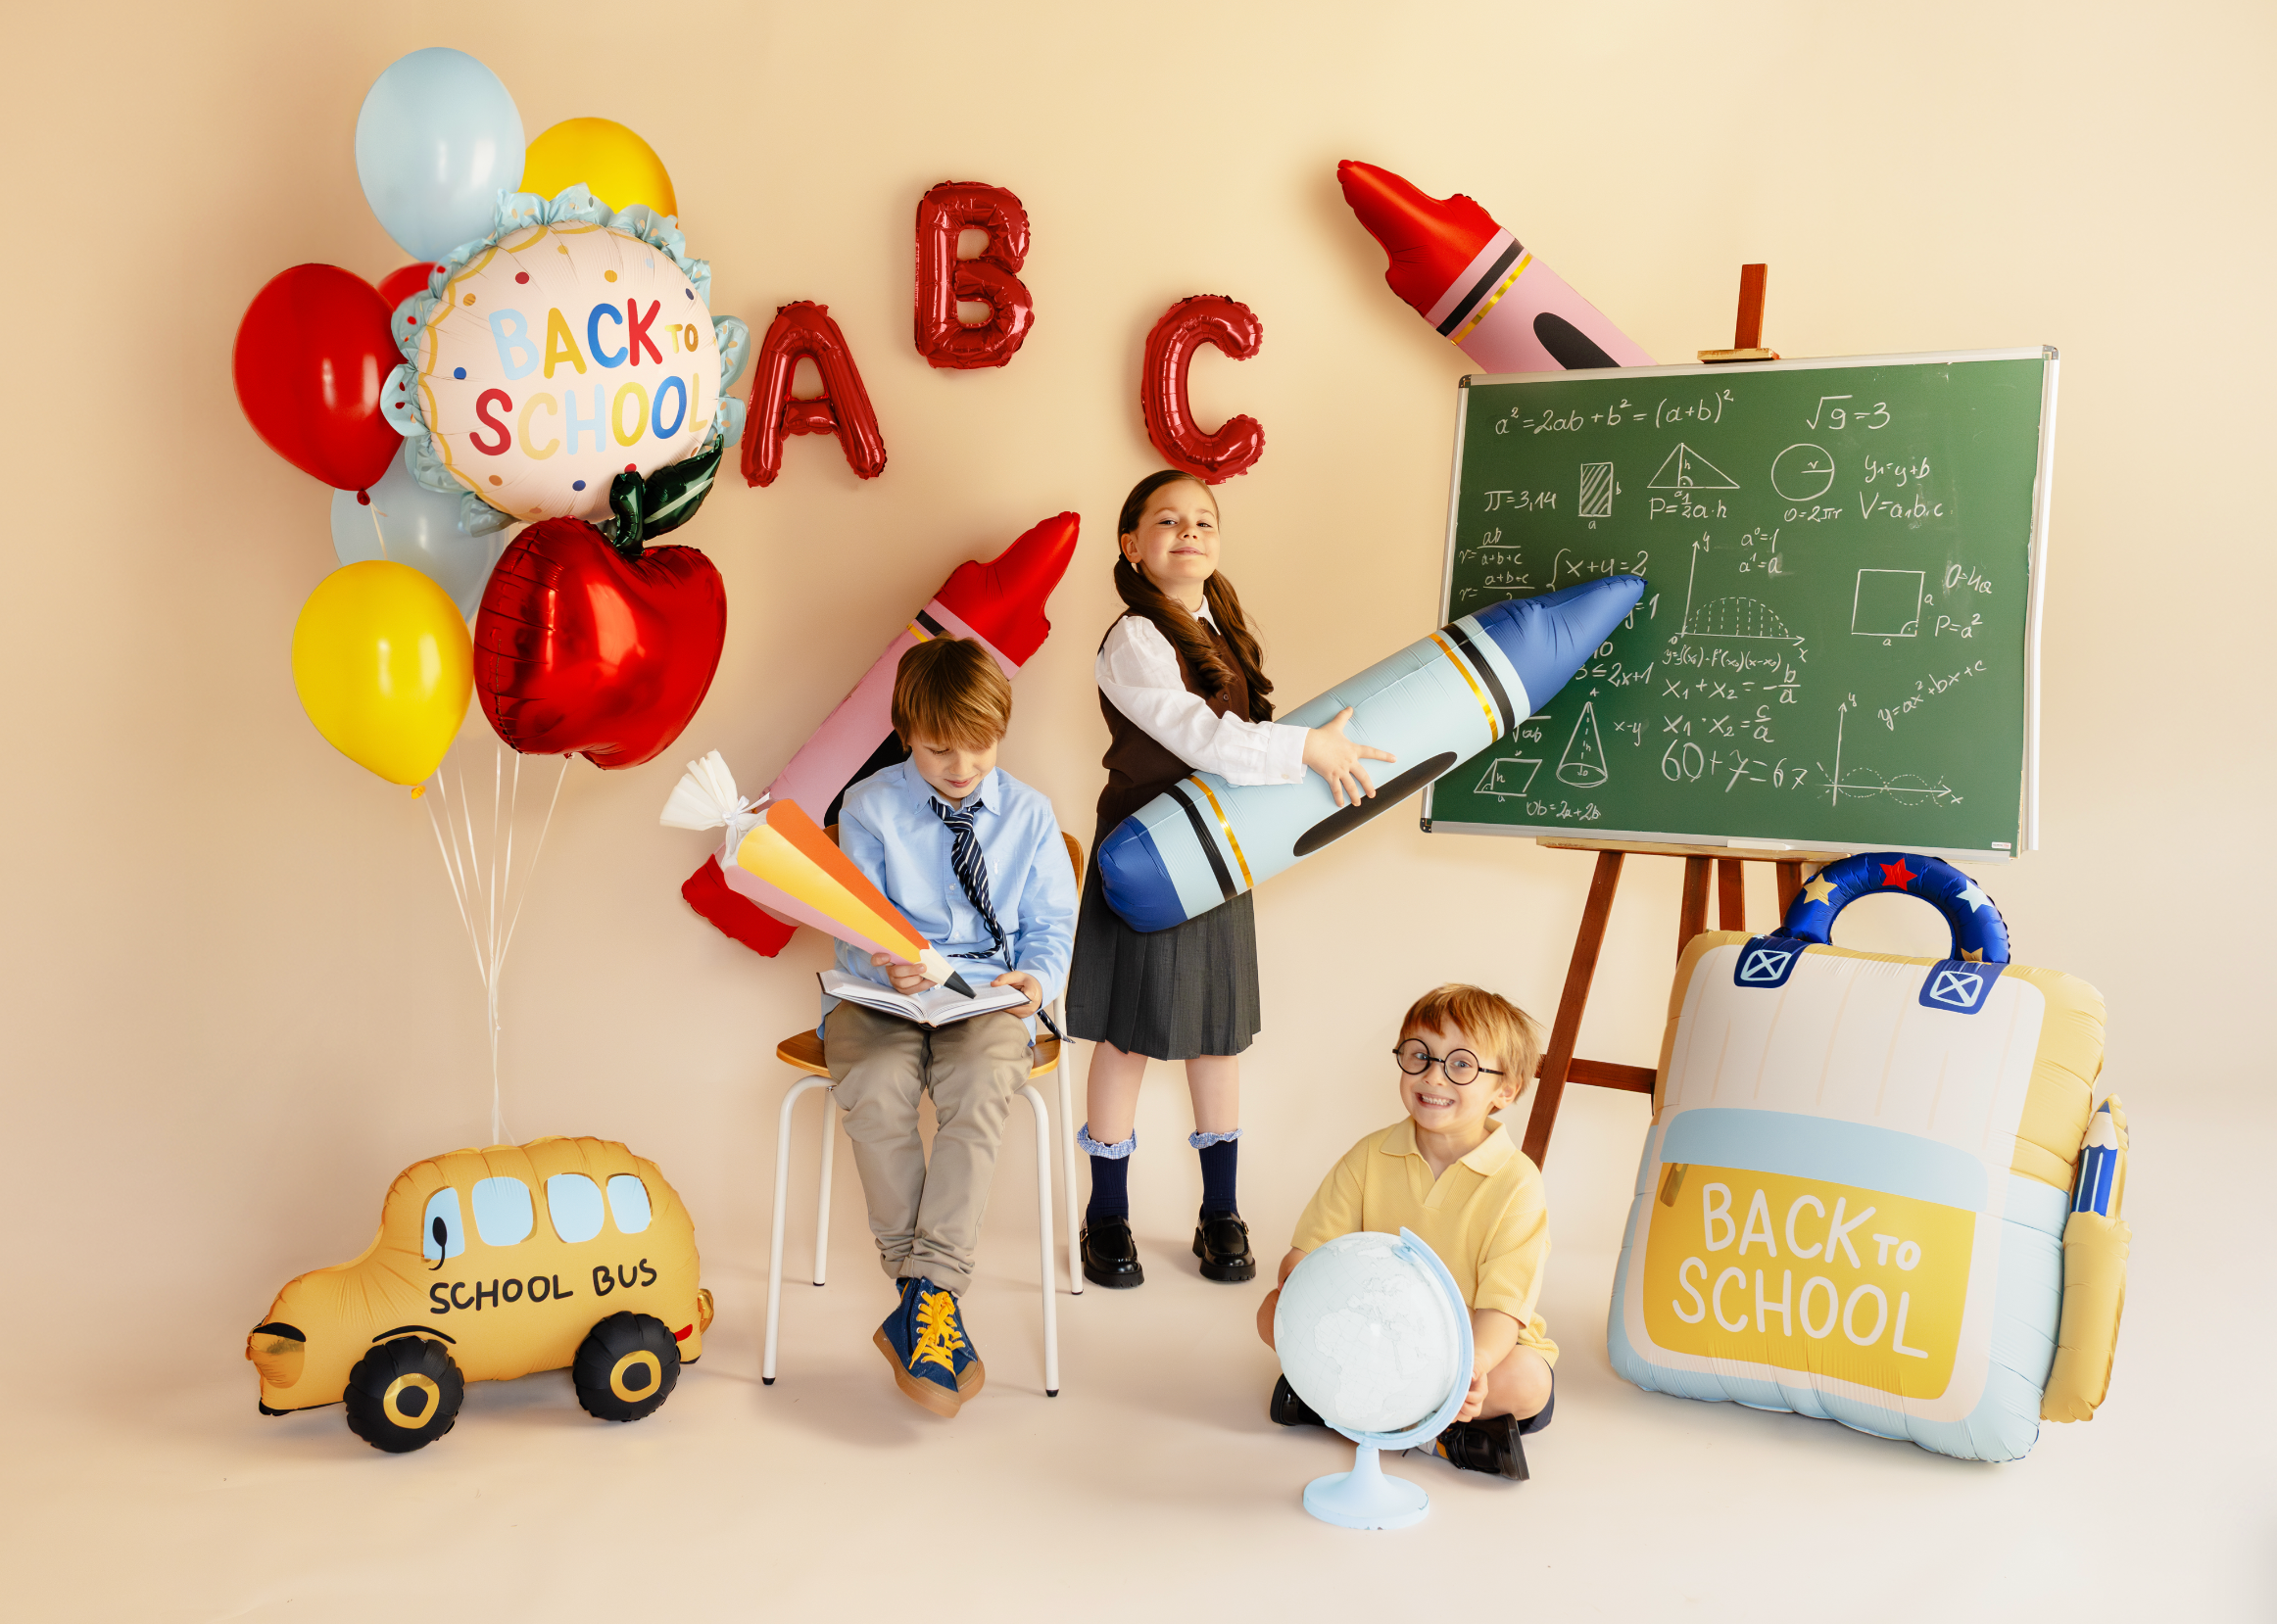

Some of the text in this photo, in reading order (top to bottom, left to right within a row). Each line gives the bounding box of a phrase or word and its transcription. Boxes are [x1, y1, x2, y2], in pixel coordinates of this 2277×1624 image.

[488, 298, 699, 380] BACK TO
[741, 180, 1267, 488] A B C
[468, 372, 708, 460] SCHOOL
[1701, 1181, 1921, 1270] BACK TO
[429, 1258, 657, 1314] SCHOOL BUS
[1671, 1257, 1929, 1360] SCHOOL
